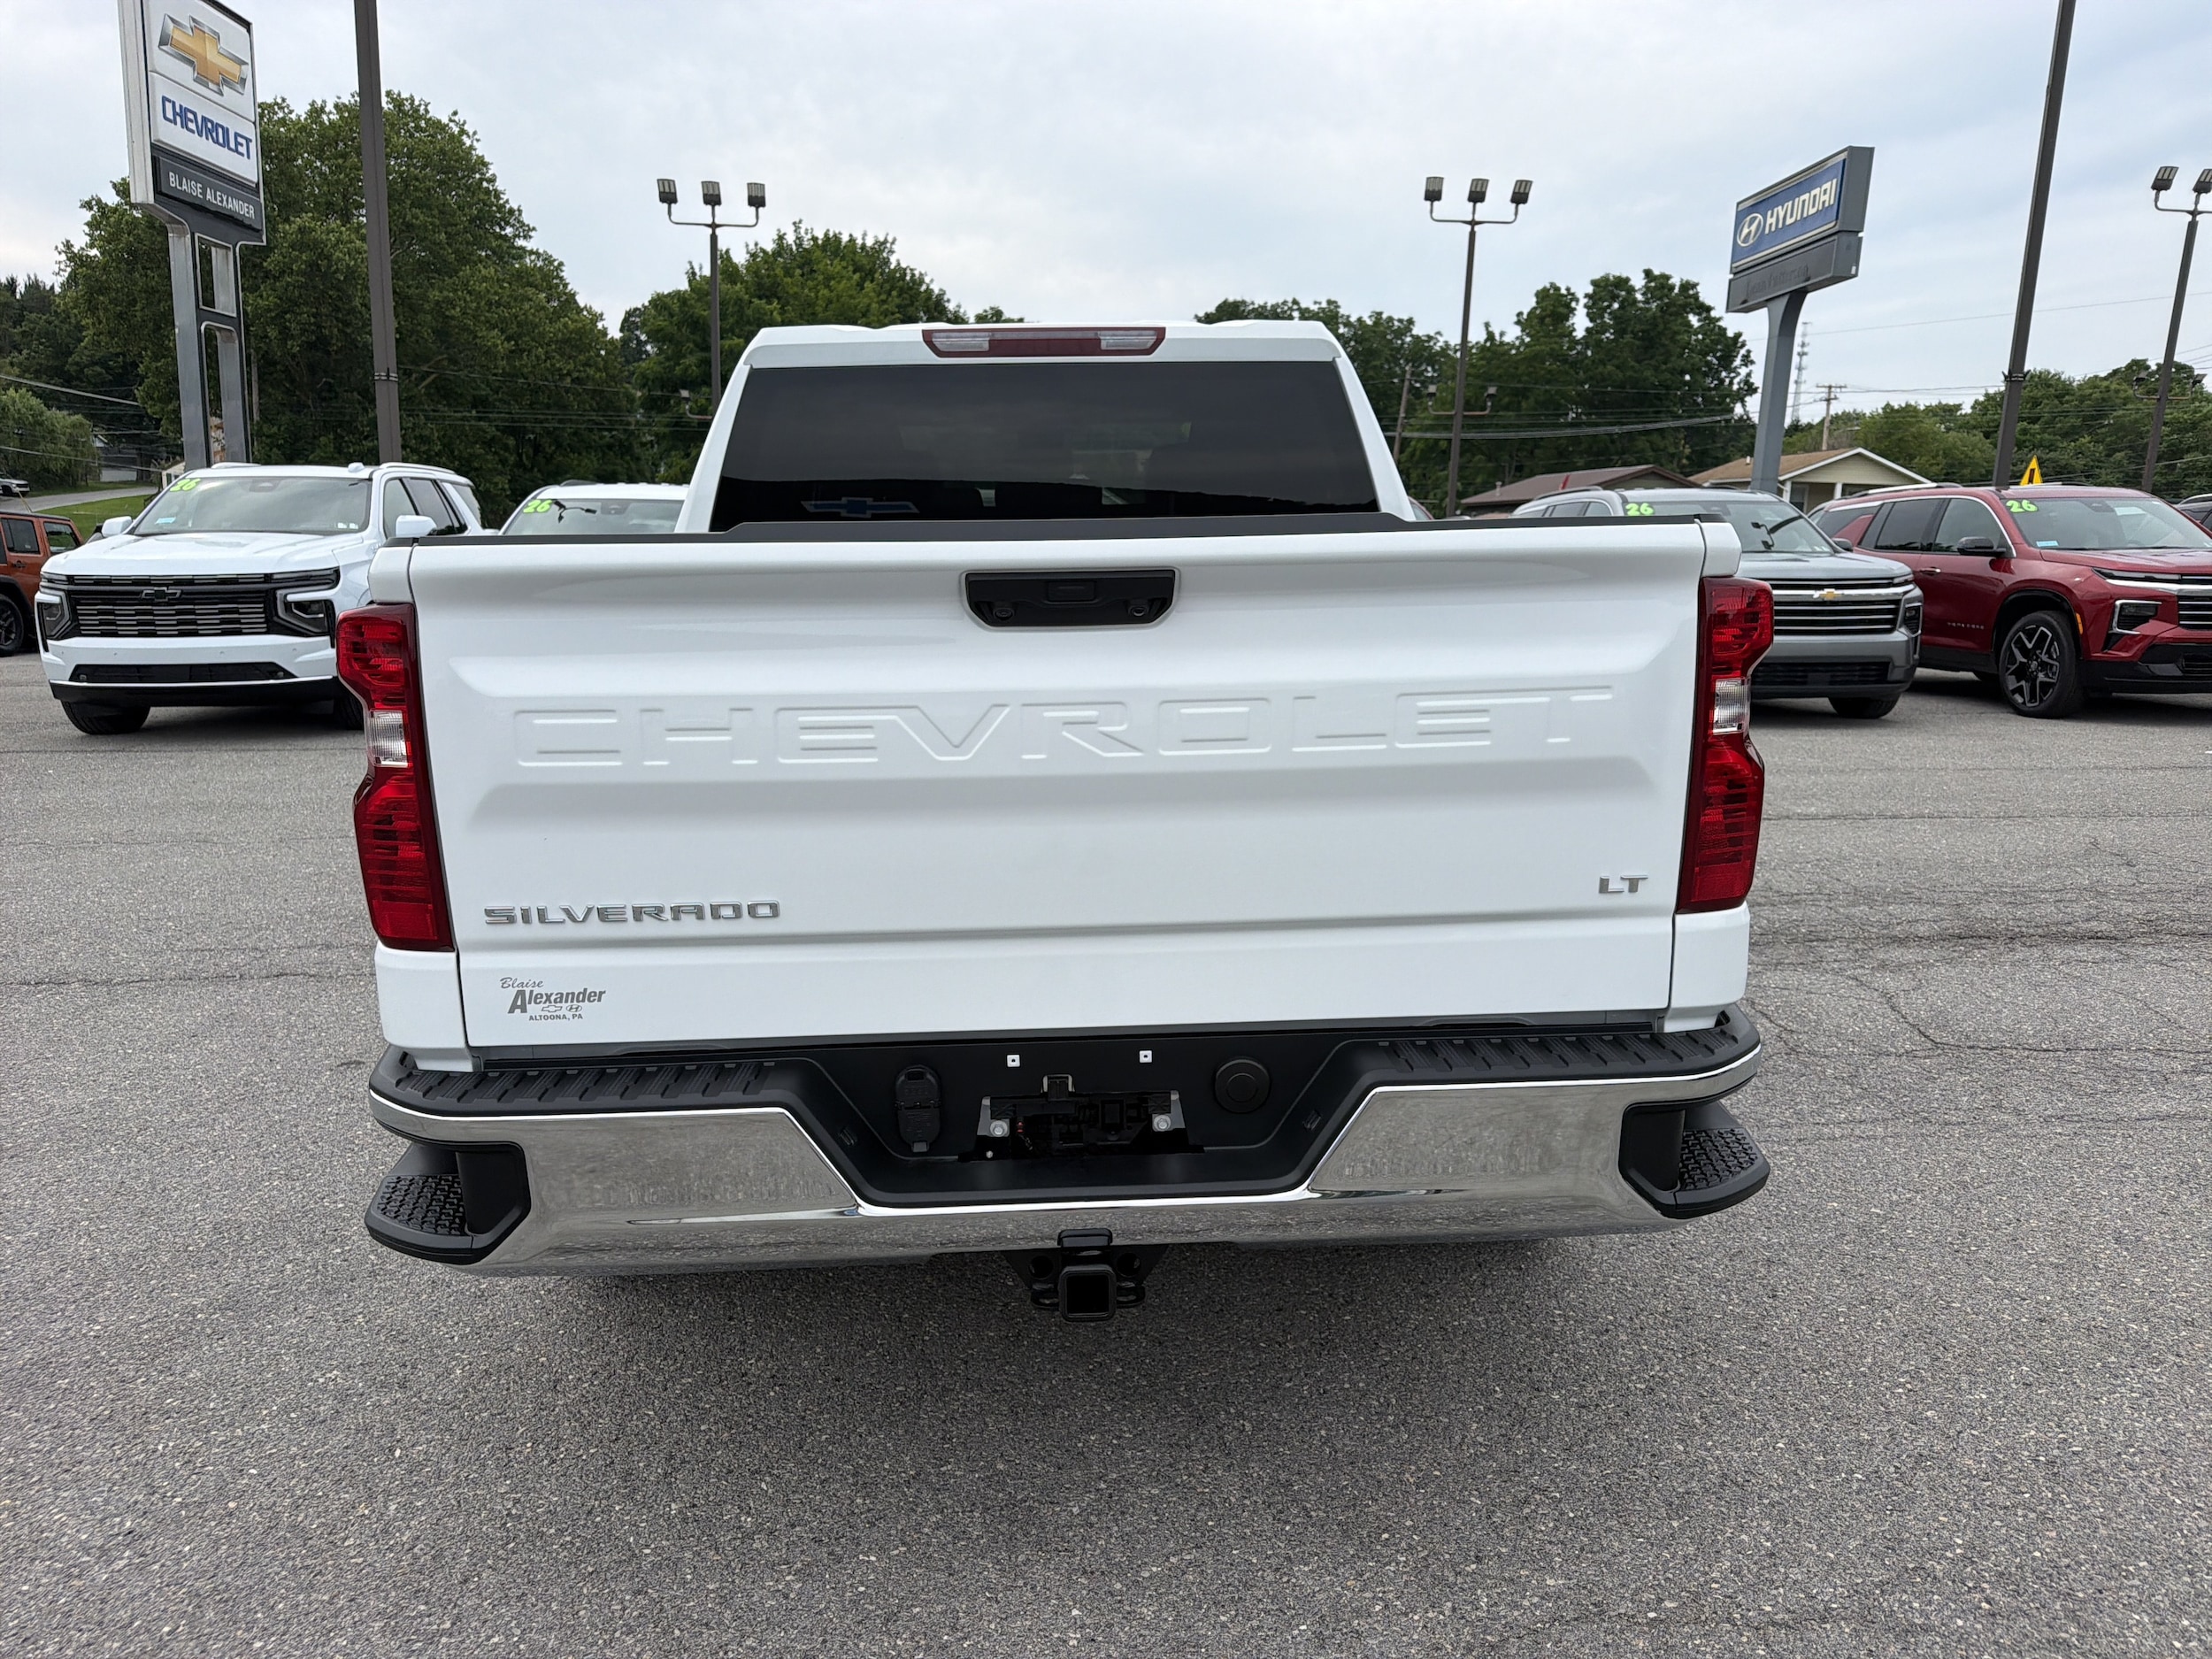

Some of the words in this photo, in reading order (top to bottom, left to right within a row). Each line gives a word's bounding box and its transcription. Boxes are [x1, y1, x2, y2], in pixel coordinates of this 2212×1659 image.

[161, 95, 252, 159] CHEVROLET
[168, 173, 204, 200] BLAISE
[205, 187, 256, 220] ALEXANDER
[1765, 178, 1838, 234] HYUNDAI
[169, 478, 201, 492] 26
[522, 499, 553, 513] 26
[1624, 502, 1655, 517] 26
[2005, 499, 2039, 512] 26
[513, 685, 1613, 768] CHEVROLET
[1598, 875, 1648, 894] LT
[484, 900, 780, 925] SILVERADO
[499, 977, 543, 988] Blaise
[507, 987, 606, 1014] Alexander
